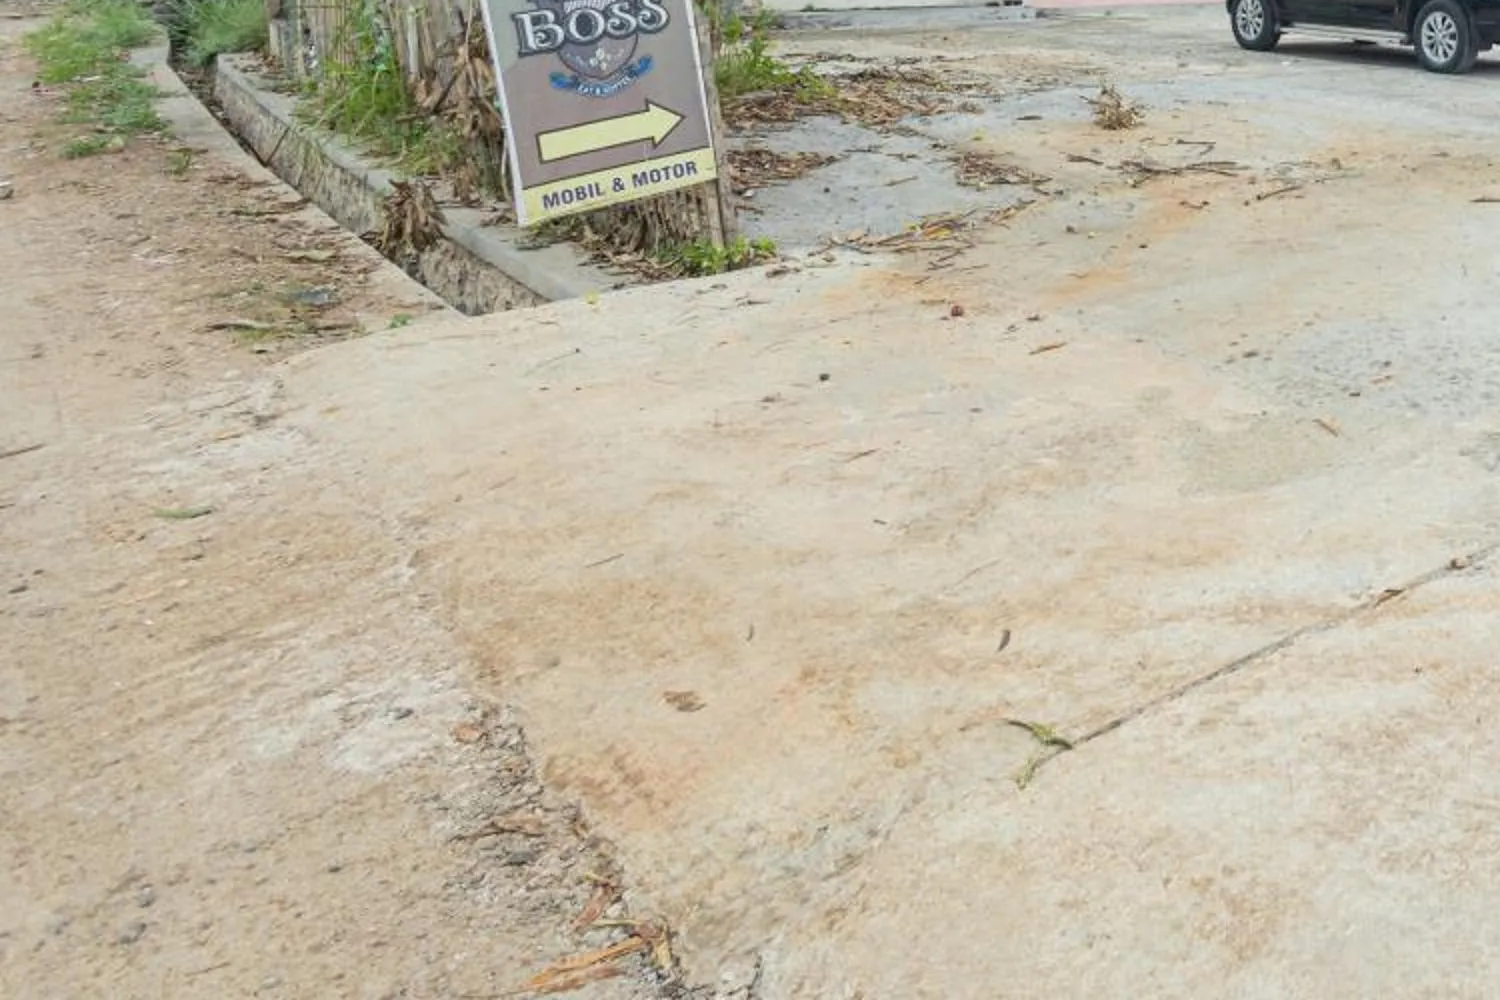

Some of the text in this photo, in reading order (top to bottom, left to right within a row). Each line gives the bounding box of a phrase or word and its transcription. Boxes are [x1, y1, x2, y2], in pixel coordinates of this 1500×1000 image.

[542, 161, 698, 209] MOBIL & MOTOR
